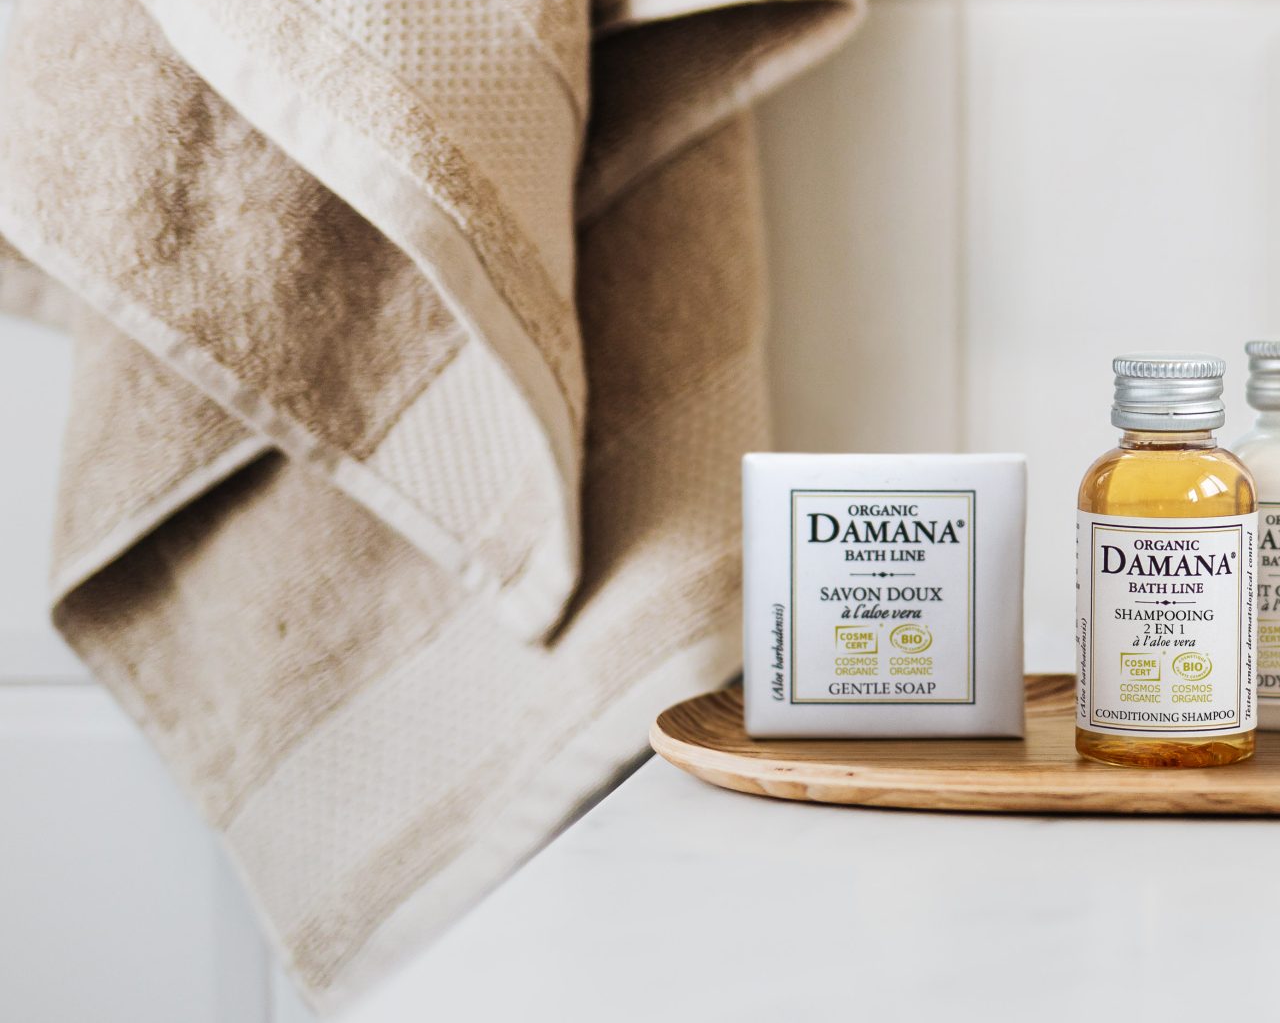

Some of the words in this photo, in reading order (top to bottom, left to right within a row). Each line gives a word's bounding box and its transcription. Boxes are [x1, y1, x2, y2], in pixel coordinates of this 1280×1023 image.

[848, 505, 918, 516] ORGANIC
[1134, 540, 1199, 551] ORGANIC
[845, 550, 886, 561] BATH
[890, 550, 925, 561] LINE
[1129, 582, 1167, 593] BATH
[1171, 583, 1203, 593] LINE
[820, 587, 881, 601] SAVON
[887, 587, 943, 601] DOUX
[1261, 600, 1269, 611] à
[841, 606, 850, 619] à
[892, 609, 922, 619] vera
[1115, 609, 1214, 621] SHAMPOOING
[1144, 624, 1150, 634] 2
[1155, 624, 1174, 634] EN
[1180, 624, 1184, 634] 1
[840, 633, 873, 641] COSME
[901, 634, 922, 644] BIO
[1133, 636, 1140, 646] à
[835, 657, 878, 665] COSMOS
[890, 657, 933, 665] COSMOS
[1125, 659, 1156, 667] COSME
[835, 667, 878, 675] ORGANIC
[890, 667, 933, 675] ORGANIC
[1183, 662, 1203, 671] BIO
[828, 683, 890, 694] GENTLE
[894, 683, 936, 694] SOAP
[1120, 684, 1160, 692] COSMOS
[1120, 694, 1160, 703] ORGANIC
[1172, 694, 1212, 702] ORGANIC
[1095, 709, 1179, 722] CONDITIONING
[1181, 709, 1235, 722] SHAMPOO
